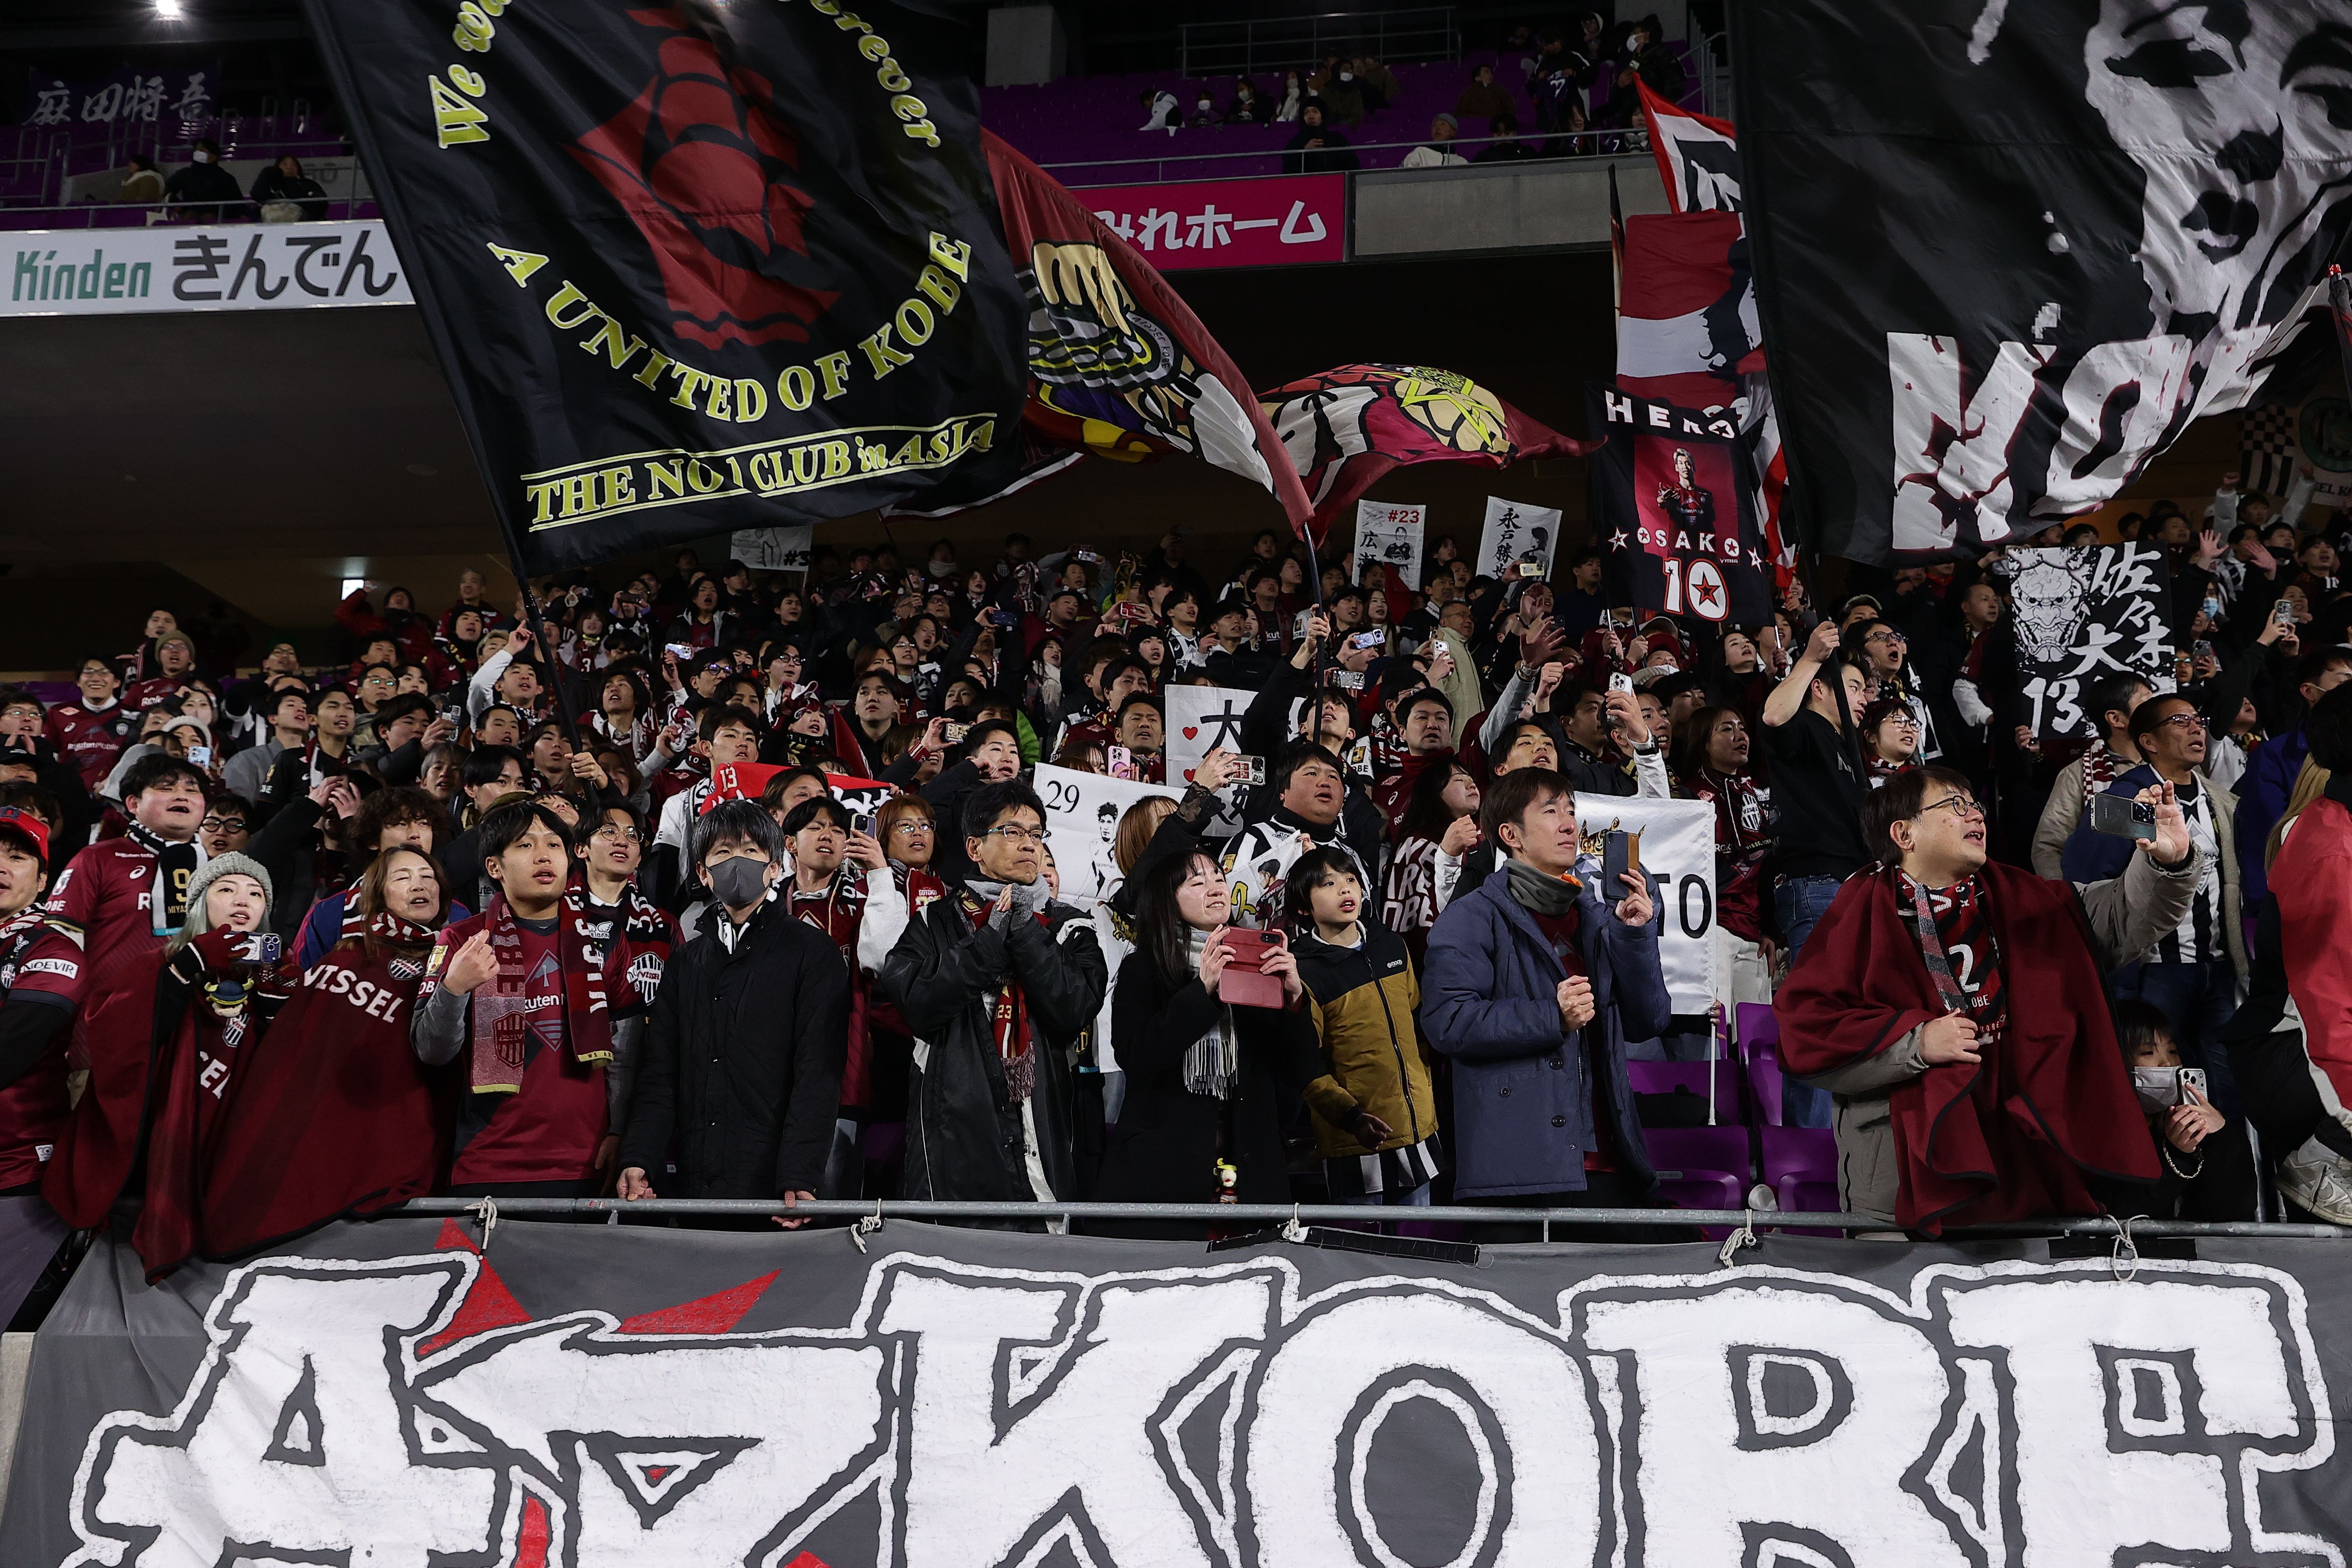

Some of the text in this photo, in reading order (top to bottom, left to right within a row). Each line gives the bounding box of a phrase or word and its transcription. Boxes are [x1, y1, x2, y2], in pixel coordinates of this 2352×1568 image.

[23, 72, 212, 126] 麻田将吾
[428, 64, 490, 149] We
[12, 250, 151, 301] Kinden
[172, 230, 398, 301] きんでん
[486, 231, 972, 424] A UNITED OF KOBE
[527, 465, 636, 524] THE
[749, 440, 851, 491] CLUB
[855, 436, 888, 472] in
[889, 420, 995, 466] ASIA
[1388, 509, 1420, 524] #23
[1637, 526, 1740, 557] OSAKO
[1663, 557, 1730, 621] 10
[2090, 541, 2176, 668] 佐々木
[2022, 677, 2084, 738] 13
[720, 766, 738, 792] 13
[1045, 780, 1081, 814] 29
[23, 960, 75, 976] NOEVIR
[303, 964, 405, 1024] VISSEL
[997, 1004, 1012, 1019] 23
[865, 1254, 2338, 1568] KOBE
